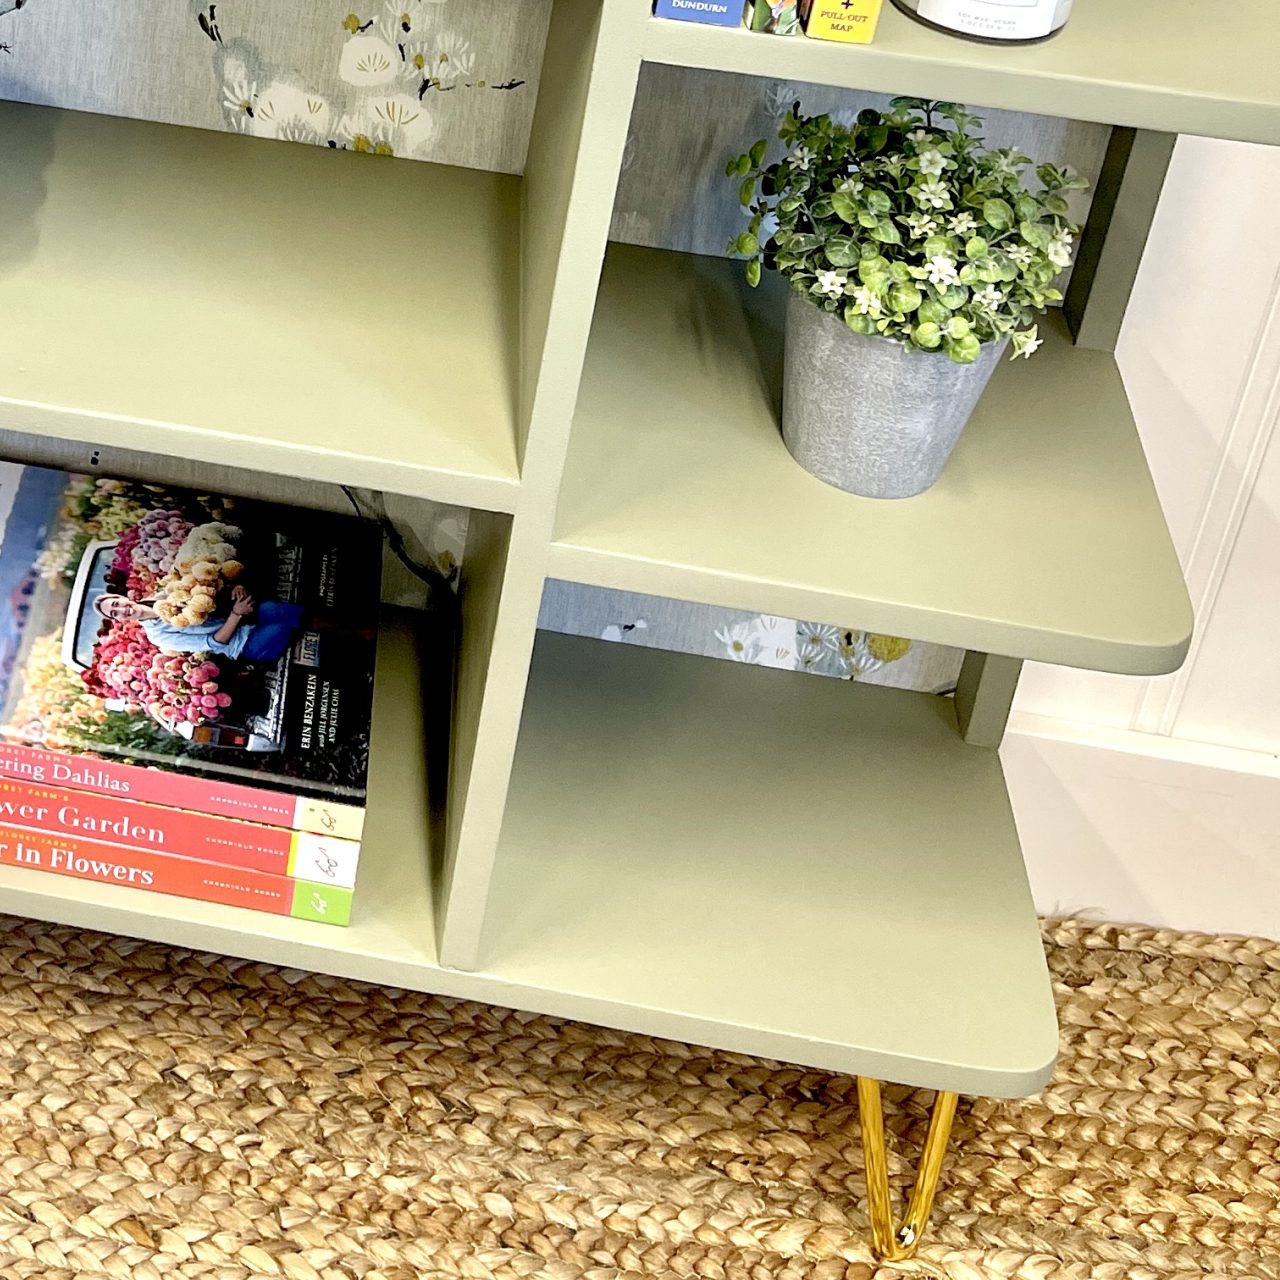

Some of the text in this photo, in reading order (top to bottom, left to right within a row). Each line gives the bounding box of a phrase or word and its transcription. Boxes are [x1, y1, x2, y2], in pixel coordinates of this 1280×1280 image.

[672, 0, 728, 13] DUNDURN
[830, 23, 853, 32] MAP
[301, 726, 312, 749] ERIN
[329, 726, 337, 743] AND
[31, 751, 73, 764] FARM'S
[52, 763, 130, 792] Dahlias
[28, 787, 70, 801] FARM'S
[57, 806, 165, 844] Garden
[0, 830, 37, 843] FLORET
[16, 843, 42, 864] in
[50, 848, 154, 885] Flowers
